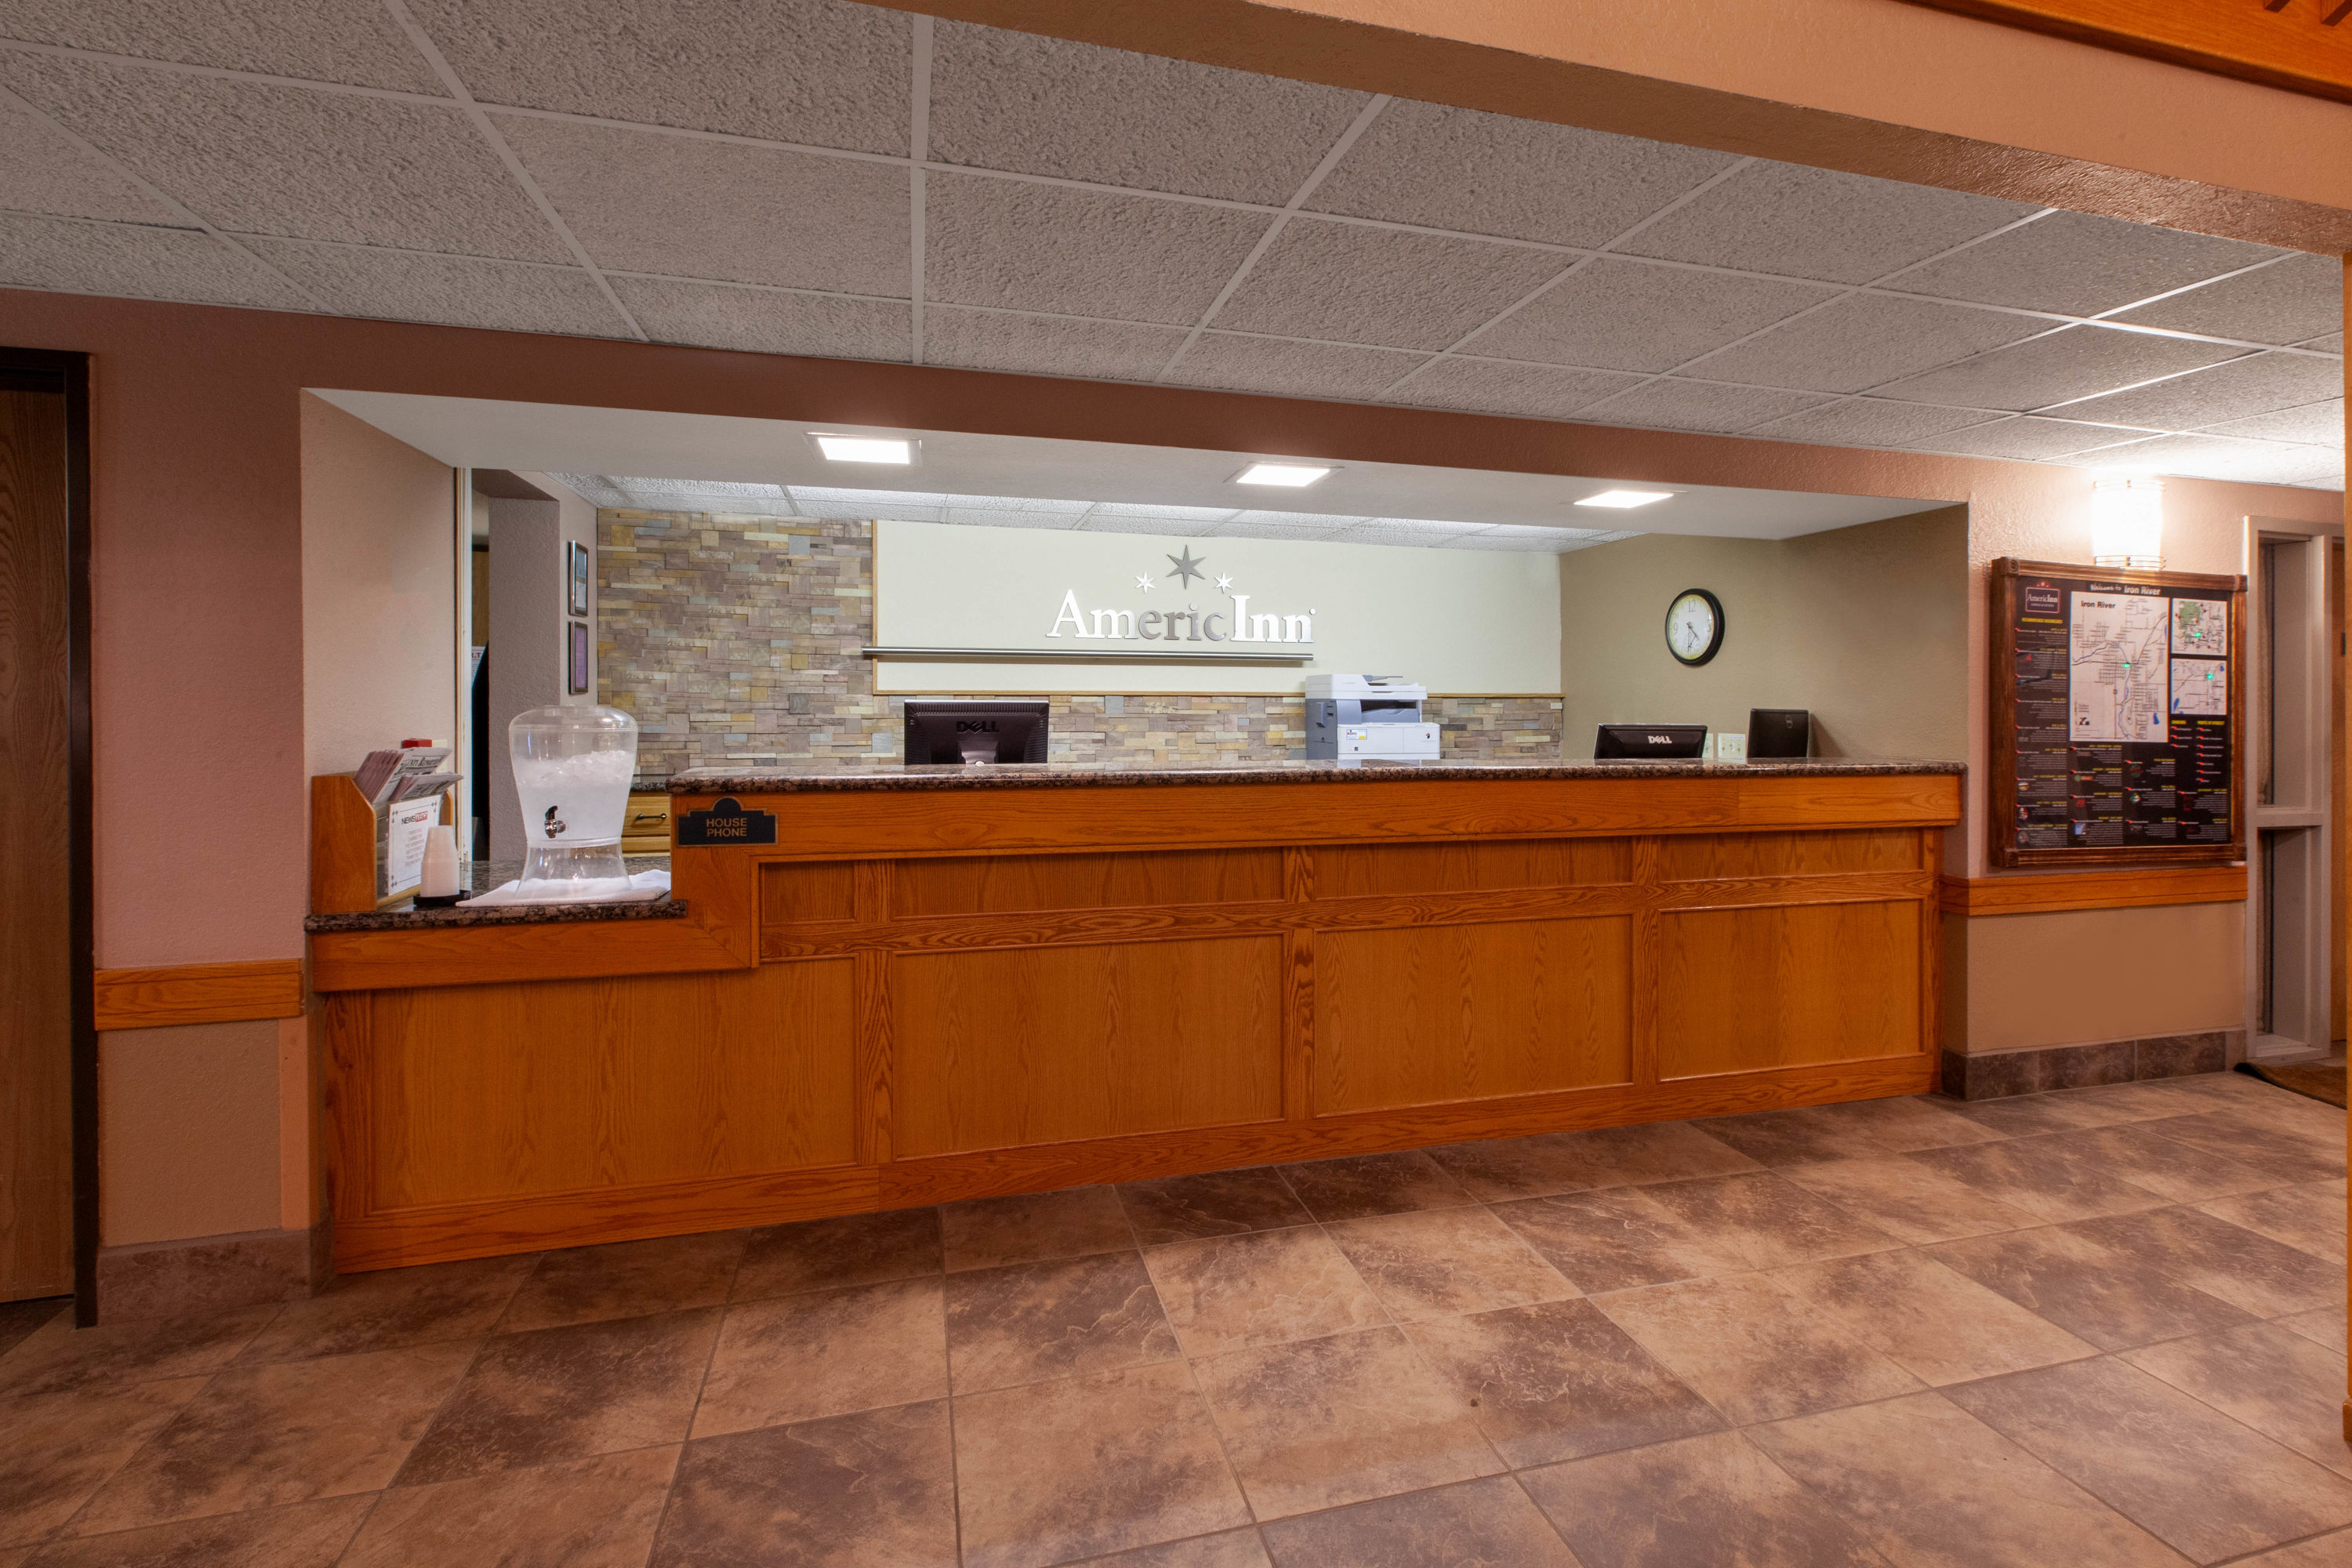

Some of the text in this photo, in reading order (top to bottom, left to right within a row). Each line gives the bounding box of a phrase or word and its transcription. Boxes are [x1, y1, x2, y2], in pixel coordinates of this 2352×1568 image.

[2124, 585, 2140, 594] Iron
[2141, 586, 2161, 596] River
[2027, 593, 2058, 603] AmericInn
[1688, 599, 1697, 613] 12
[1045, 589, 1315, 644] AmericInn
[956, 720, 1000, 734] DELL
[1648, 735, 1672, 744] DELL
[706, 818, 747, 827] HOUSE
[706, 827, 747, 837] PHONE
